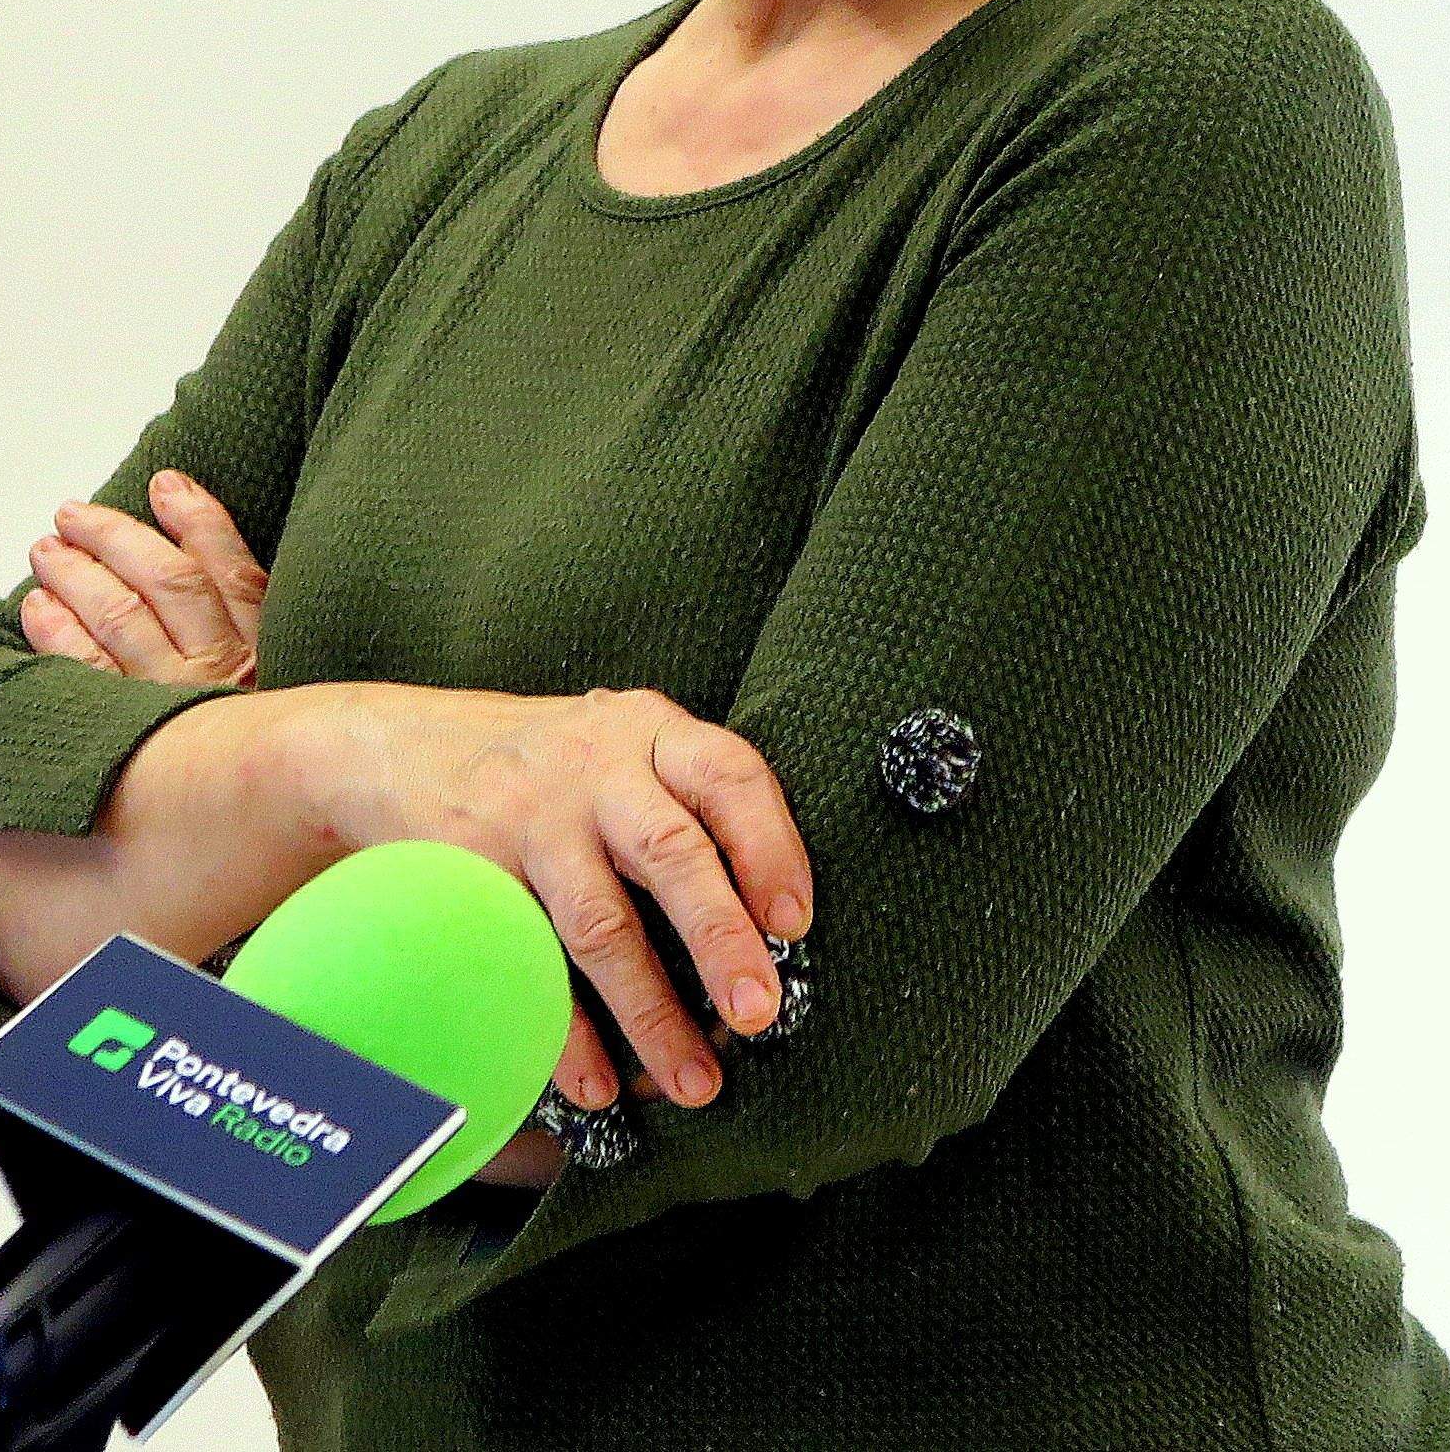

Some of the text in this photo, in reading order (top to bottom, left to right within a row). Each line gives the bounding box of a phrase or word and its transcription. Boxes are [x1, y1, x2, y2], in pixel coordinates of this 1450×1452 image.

[137, 1059, 312, 1167] Viva Radio
[152, 1037, 351, 1153] Pontevedra
